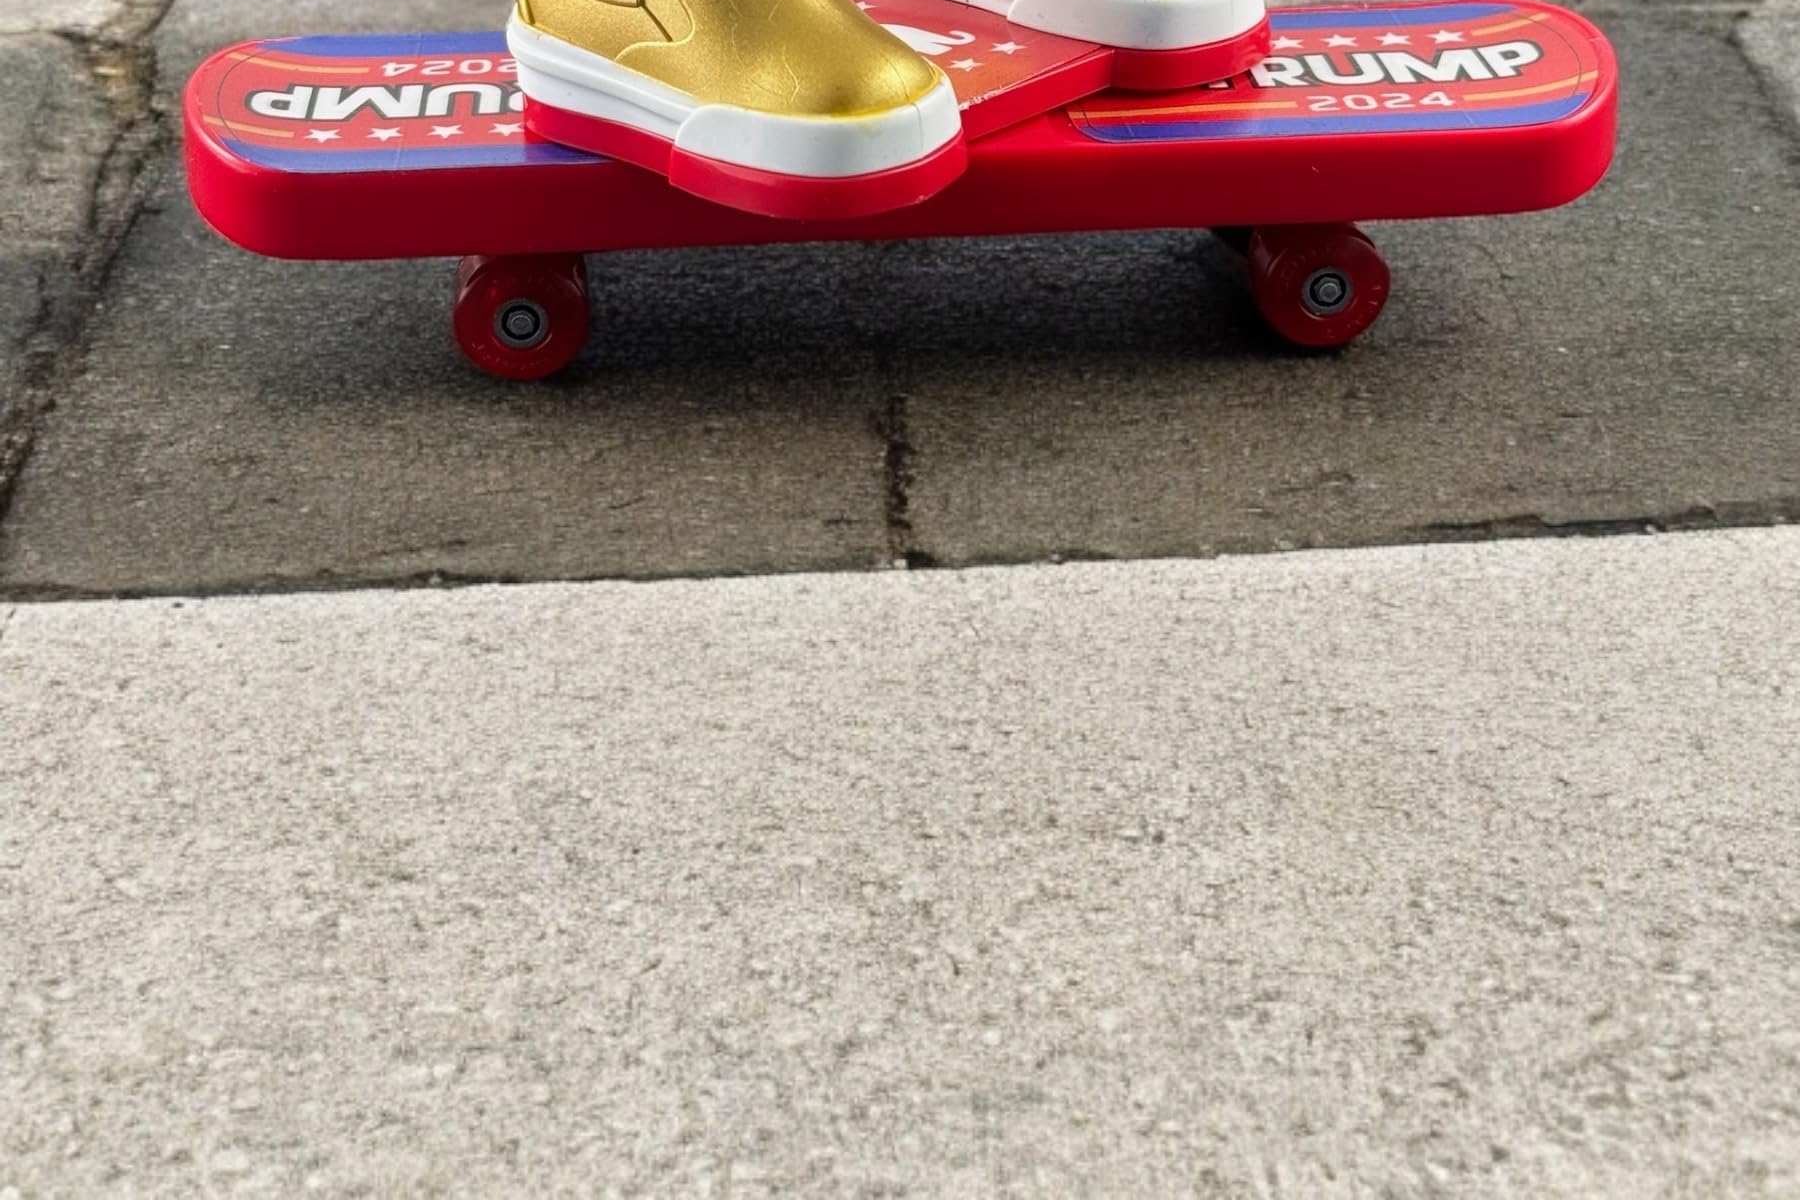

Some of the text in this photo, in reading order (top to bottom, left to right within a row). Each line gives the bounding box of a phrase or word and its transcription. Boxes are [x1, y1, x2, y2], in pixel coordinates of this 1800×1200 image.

[382, 58, 518, 77] 2024
[1202, 39, 1544, 91] RUMP
[247, 83, 525, 122] UMP
[1306, 91, 1455, 112] 2024
